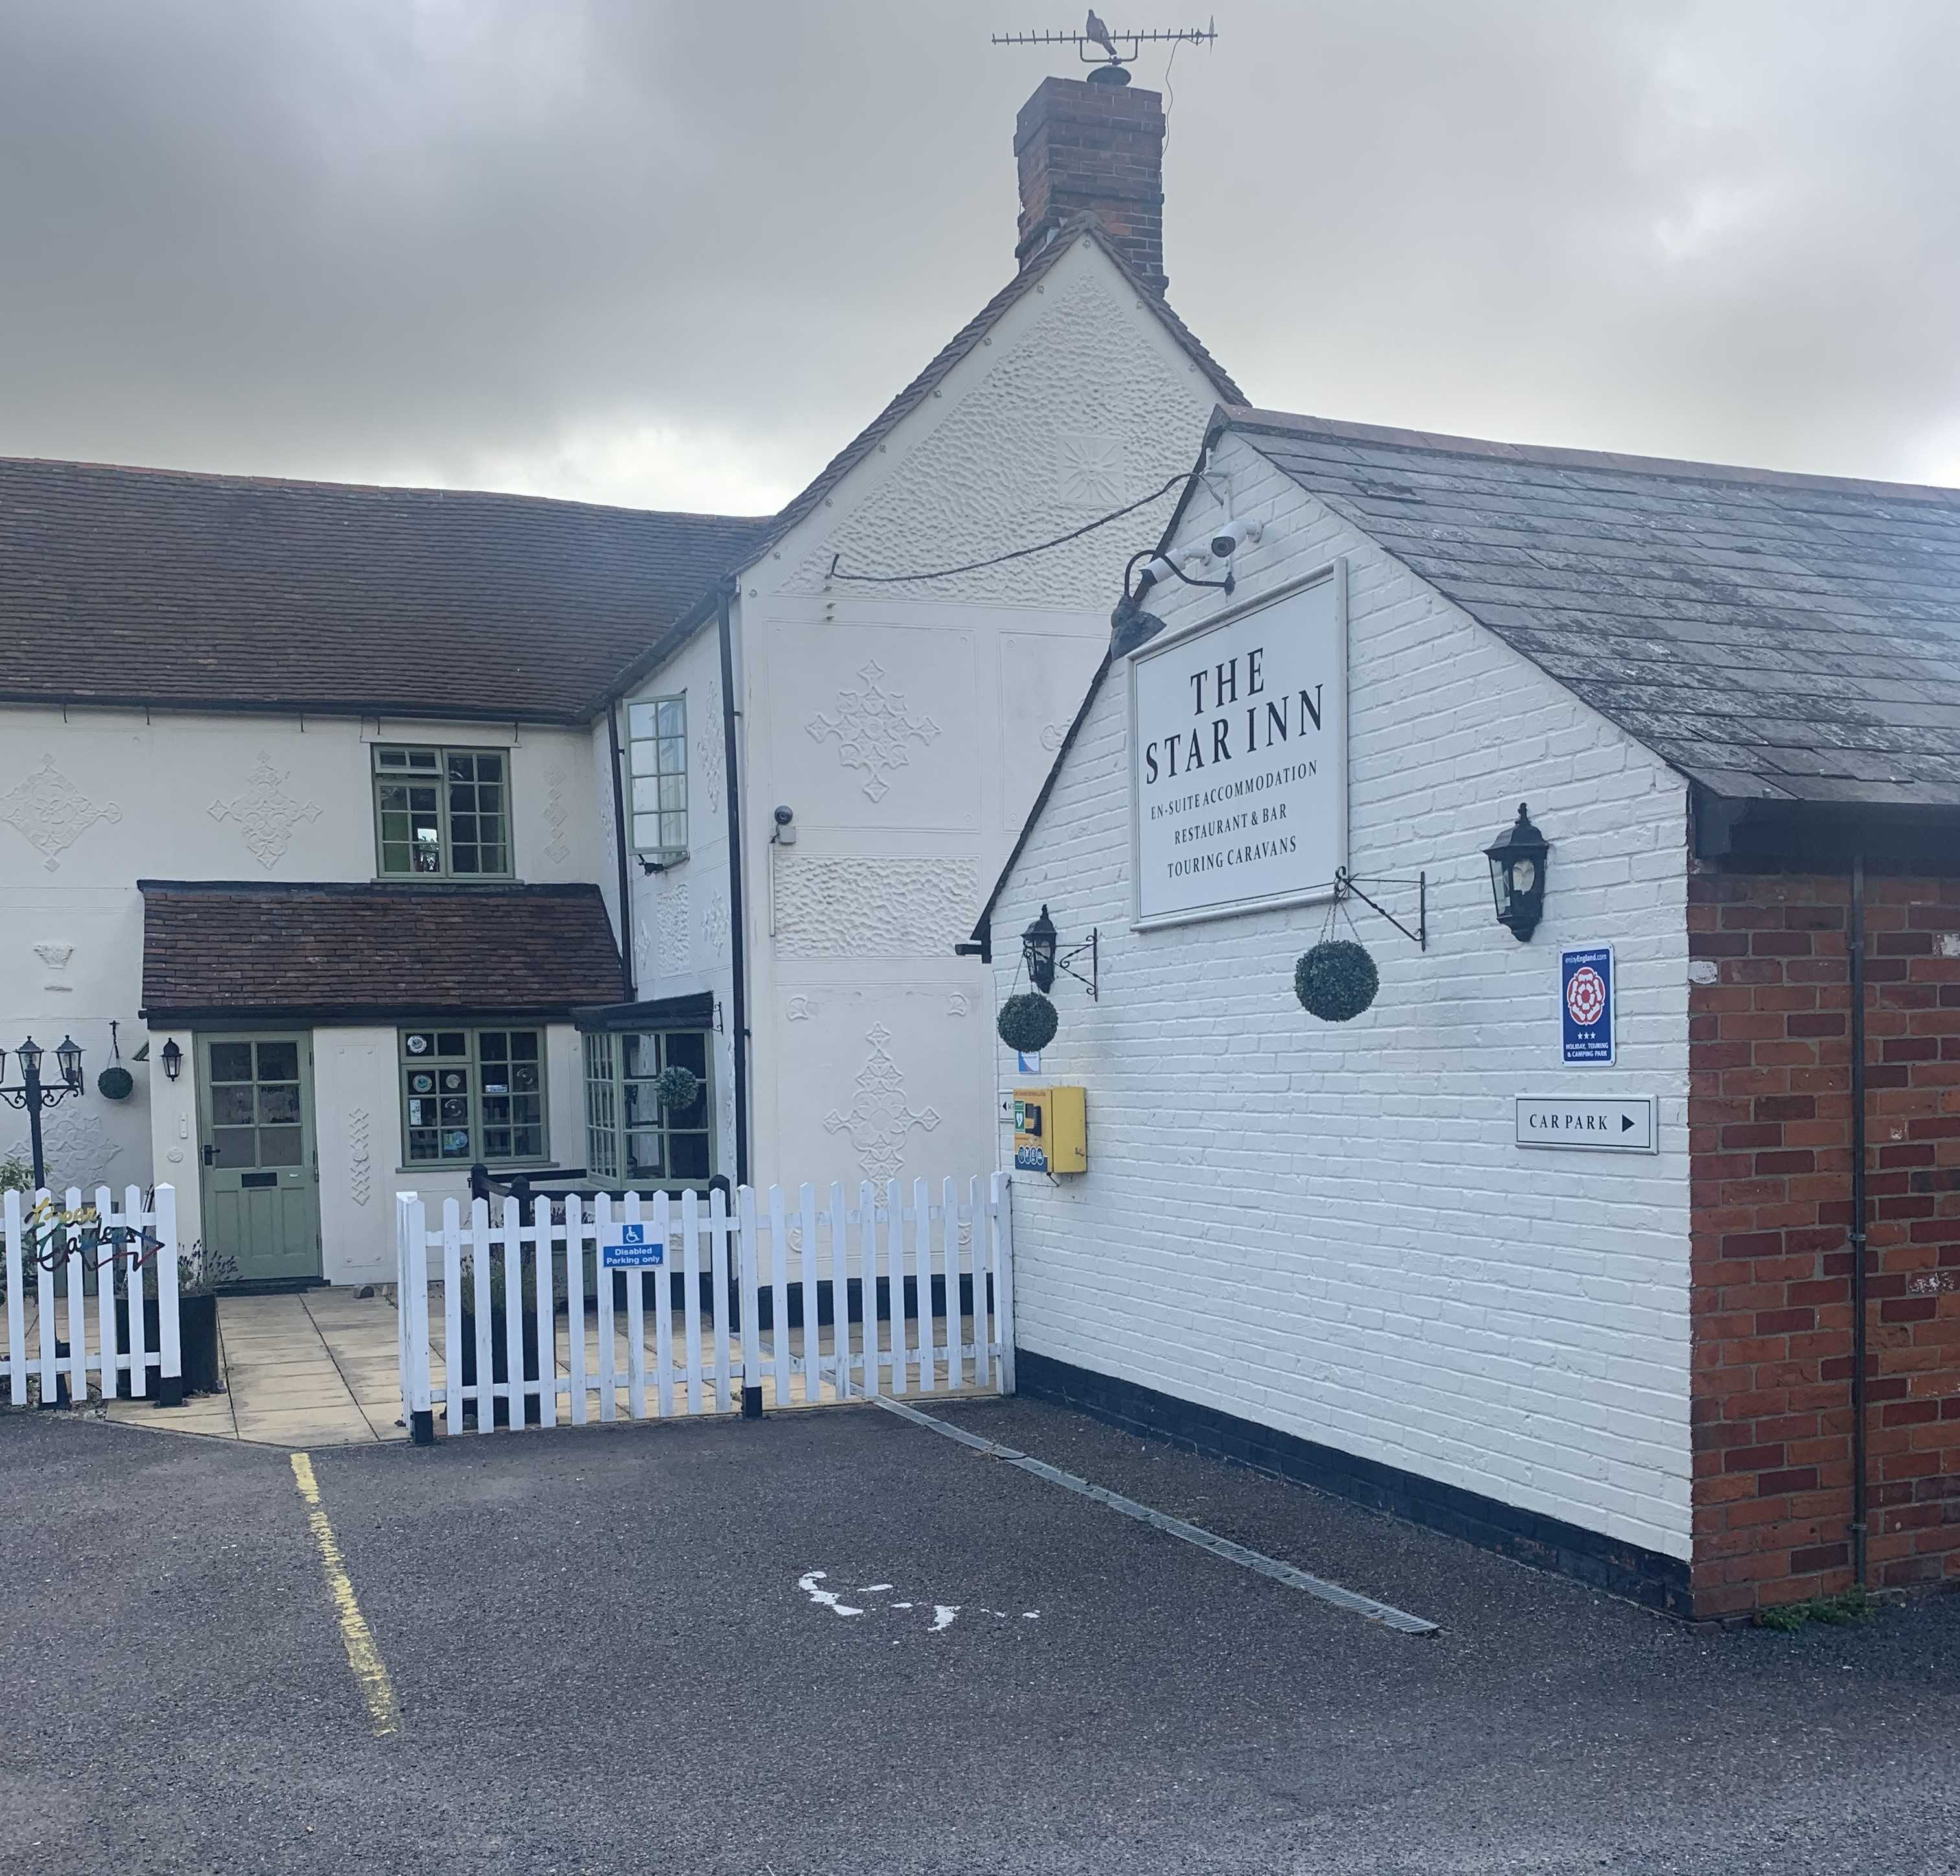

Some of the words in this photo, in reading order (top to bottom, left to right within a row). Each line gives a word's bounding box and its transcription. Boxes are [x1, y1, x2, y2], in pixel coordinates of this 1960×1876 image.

[1190, 648, 1264, 716] THE
[1145, 718, 1232, 785] STAR
[1246, 683, 1324, 753] INN
[1150, 793, 1201, 820] EN-SUITE
[1202, 760, 1318, 806] ACCOMMODATION
[1174, 813, 1248, 845] RESTAURANT
[1251, 811, 1259, 827] &
[1263, 803, 1287, 824] BAR
[1167, 852, 1224, 878] TOURING
[1227, 835, 1297, 865] CARAVANS
[1530, 1114, 1560, 1129] CAR
[1565, 1114, 1608, 1131] PARK
[614, 1247, 653, 1256] Disabled
[642, 1255, 660, 1263] only
